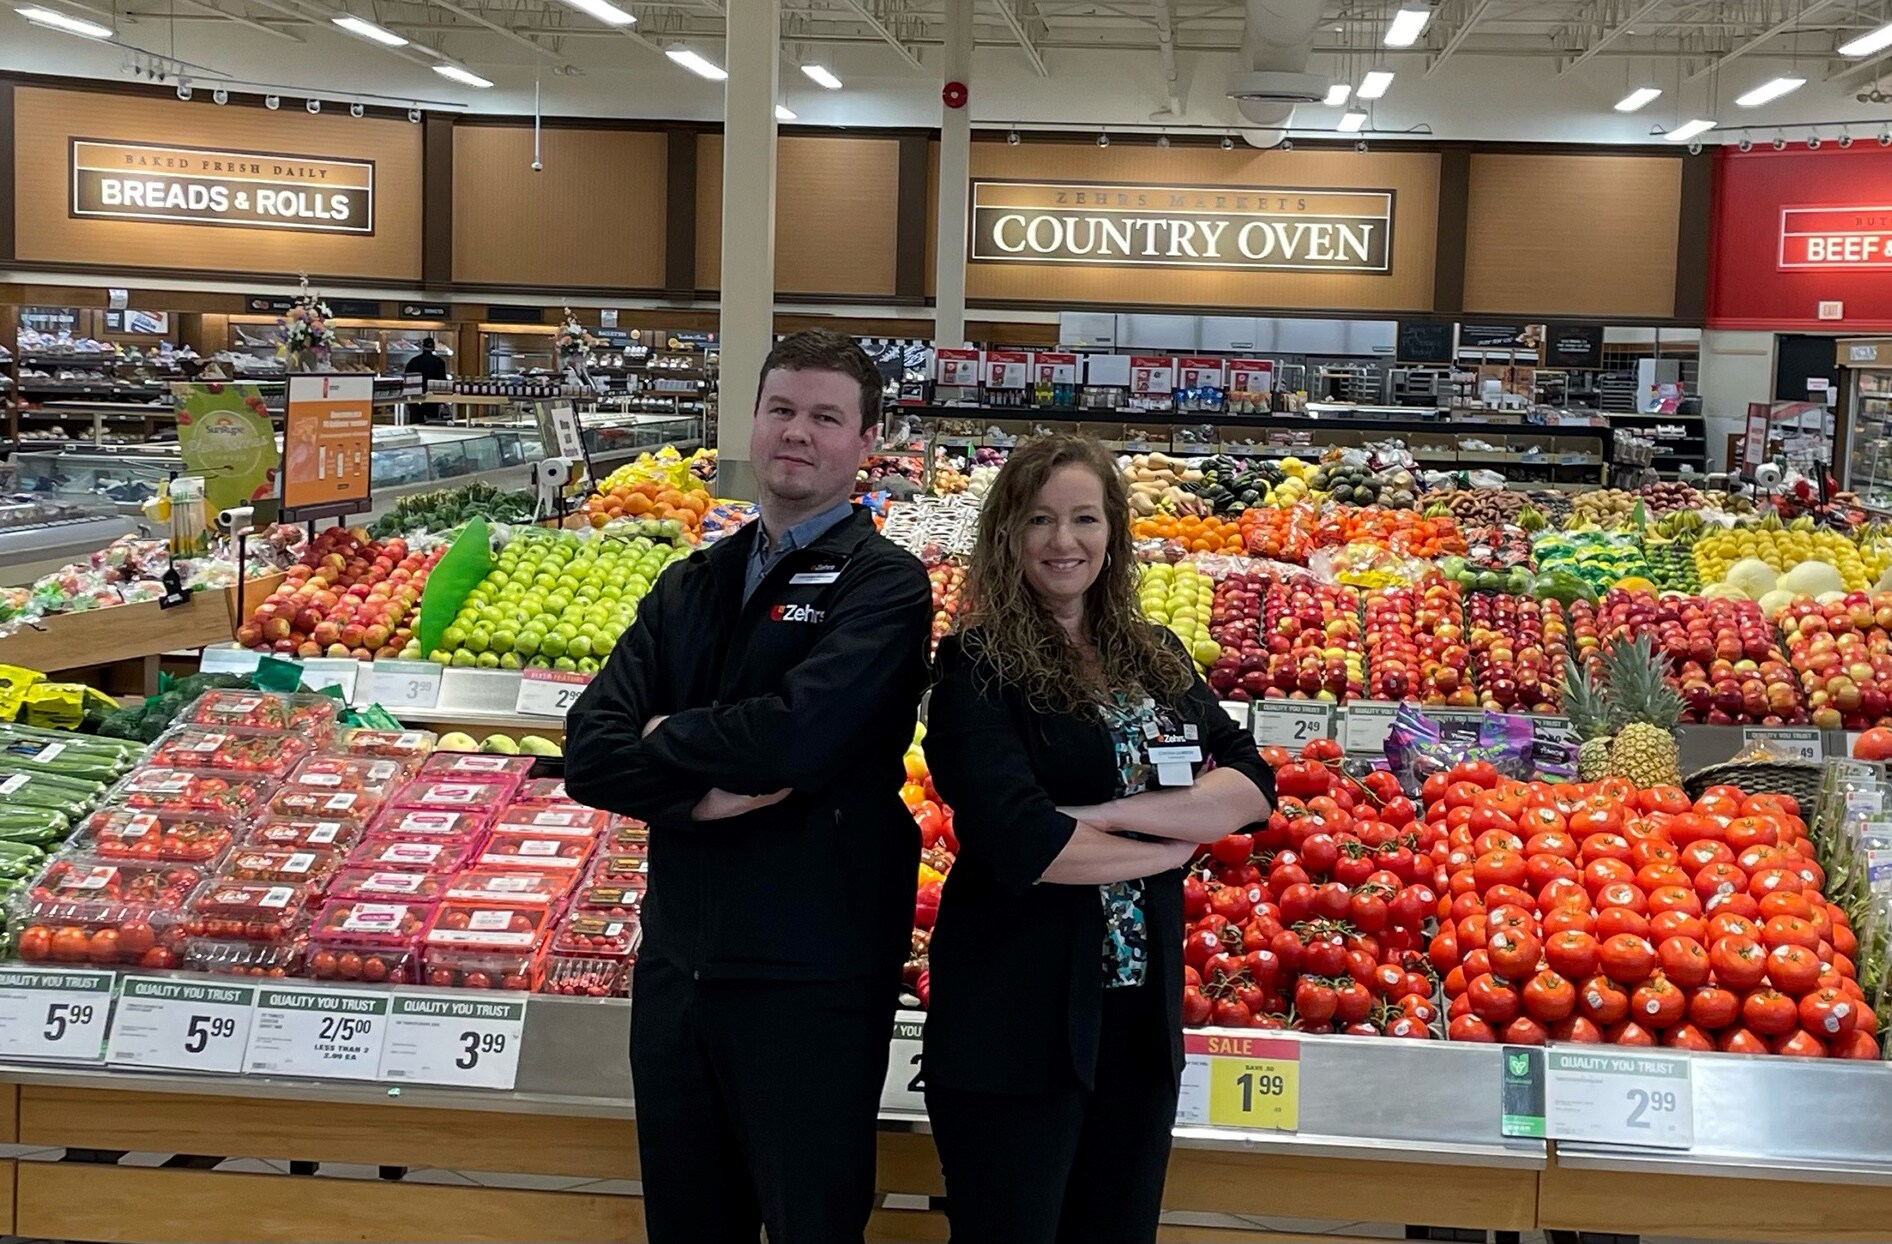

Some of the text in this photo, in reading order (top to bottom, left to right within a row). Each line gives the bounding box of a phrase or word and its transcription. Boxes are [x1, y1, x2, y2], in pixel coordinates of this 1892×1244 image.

[125, 154, 327, 178] BAKED FRESH DAILY
[101, 178, 350, 220] BREADS & ROLLS
[1056, 191, 1306, 211] ZEHRS MARKETS
[1856, 216, 1892, 226] BUT
[993, 214, 1374, 262] COUNTRY OVEN
[1807, 236, 1880, 261] BEEF
[1263, 703, 1287, 711] QUALITY
[0, 975, 100, 989] UALITY YOU TRUST
[135, 983, 241, 1001] QUALITY YOU TRUST
[269, 994, 376, 1012] QUALITY YOU TRUST
[404, 1000, 511, 1017] QUALITY YOU TRUST
[900, 1025, 922, 1037] YOU
[338, 1045, 361, 1053] THAN
[1208, 1037, 1253, 1055] SALE
[1560, 1056, 1675, 1074] QUALITY YOU TRUST
